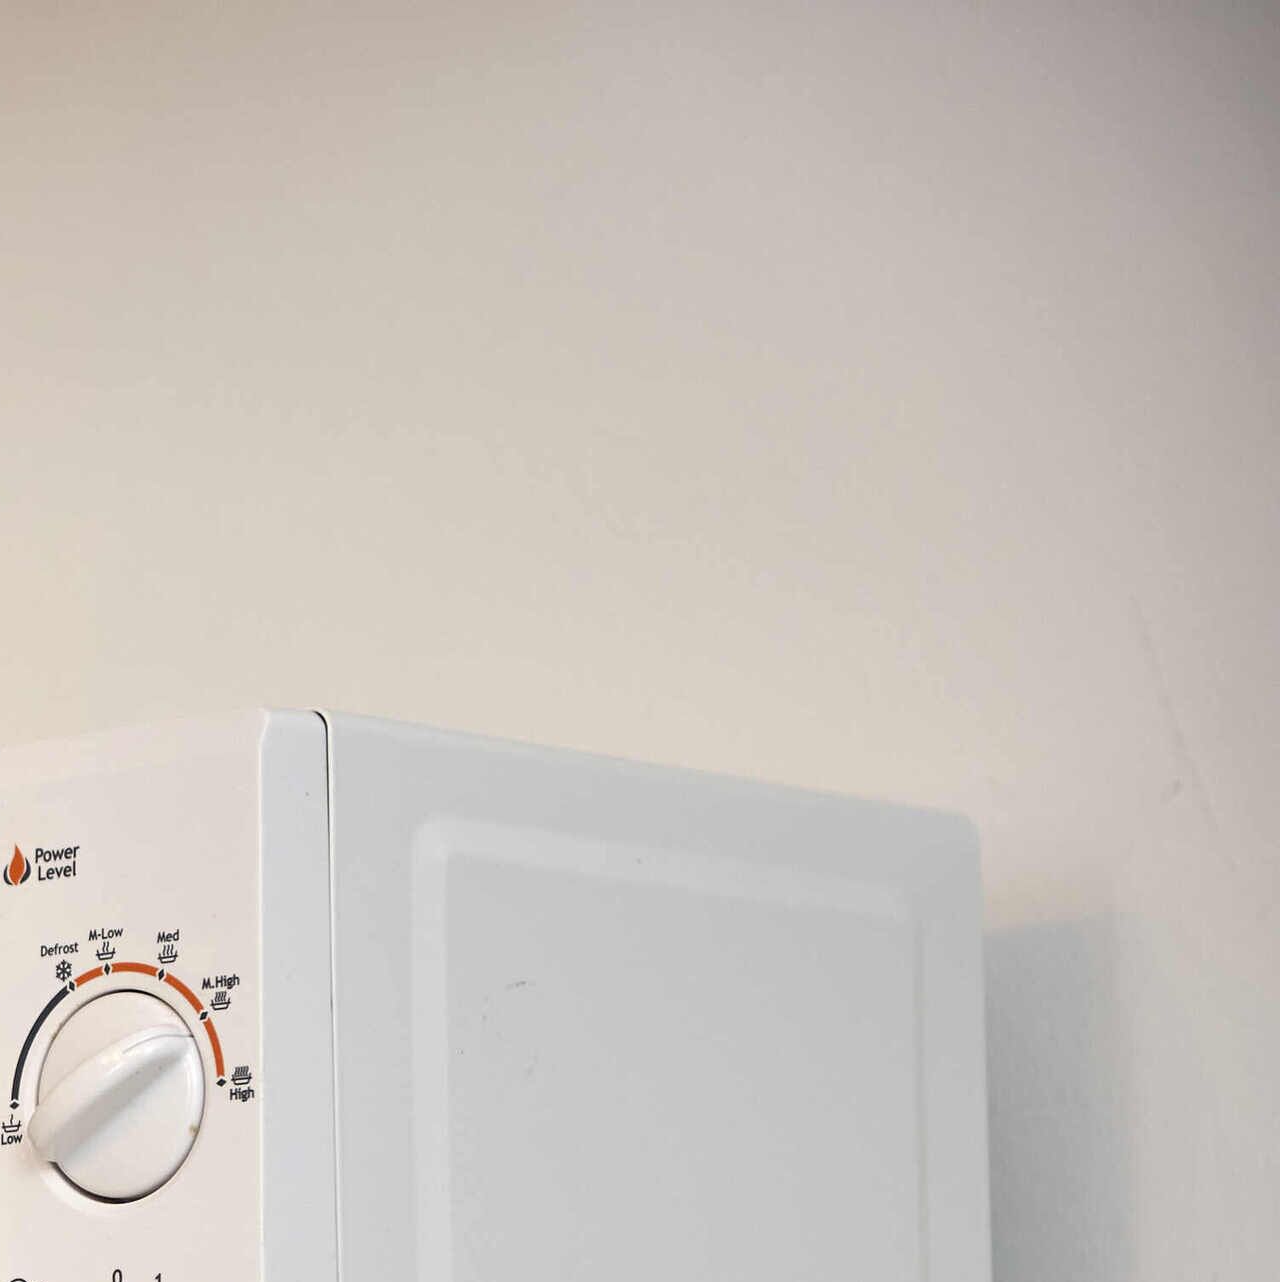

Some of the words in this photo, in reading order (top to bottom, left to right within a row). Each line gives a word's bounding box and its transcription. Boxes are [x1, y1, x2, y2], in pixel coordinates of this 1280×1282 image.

[34, 843, 80, 864] Power
[37, 861, 77, 882] Level
[88, 926, 124, 942] M-Low
[157, 929, 180, 944] Med
[40, 941, 79, 958] Defrost
[201, 973, 240, 991] M.High
[229, 1086, 255, 1102] High
[0, 1131, 23, 1146] Low
